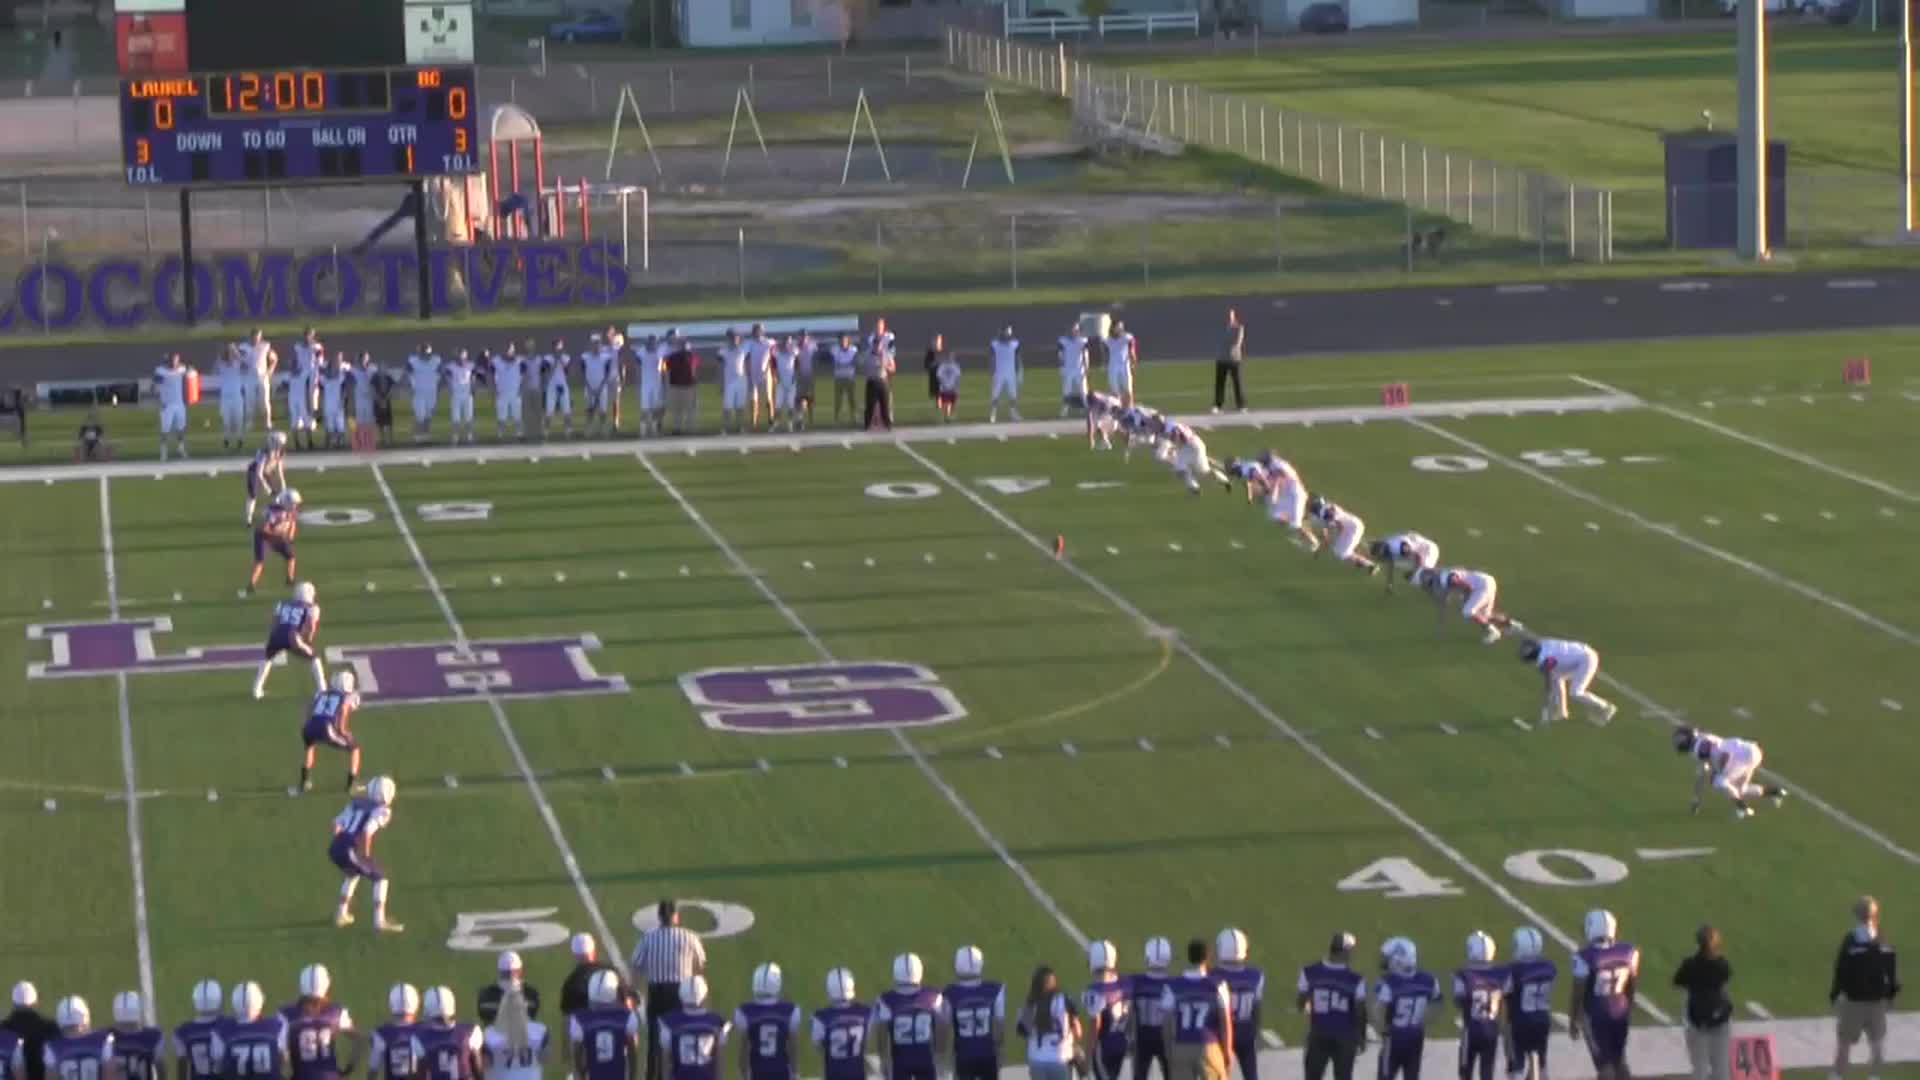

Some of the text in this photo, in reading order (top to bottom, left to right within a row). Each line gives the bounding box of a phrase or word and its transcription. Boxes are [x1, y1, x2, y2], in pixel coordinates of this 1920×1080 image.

[131, 79, 199, 97] LAUREL
[225, 72, 325, 112] 12:00
[155, 100, 173, 130] 0
[448, 87, 467, 120] 0
[176, 131, 222, 152] DOWN
[243, 130, 286, 149] TO GO
[312, 125, 367, 147] BALL ON
[388, 124, 417, 144] QTR
[456, 127, 467, 153] 3
[136, 139, 149, 164] 3
[1736, 1040, 1771, 1077] 40
